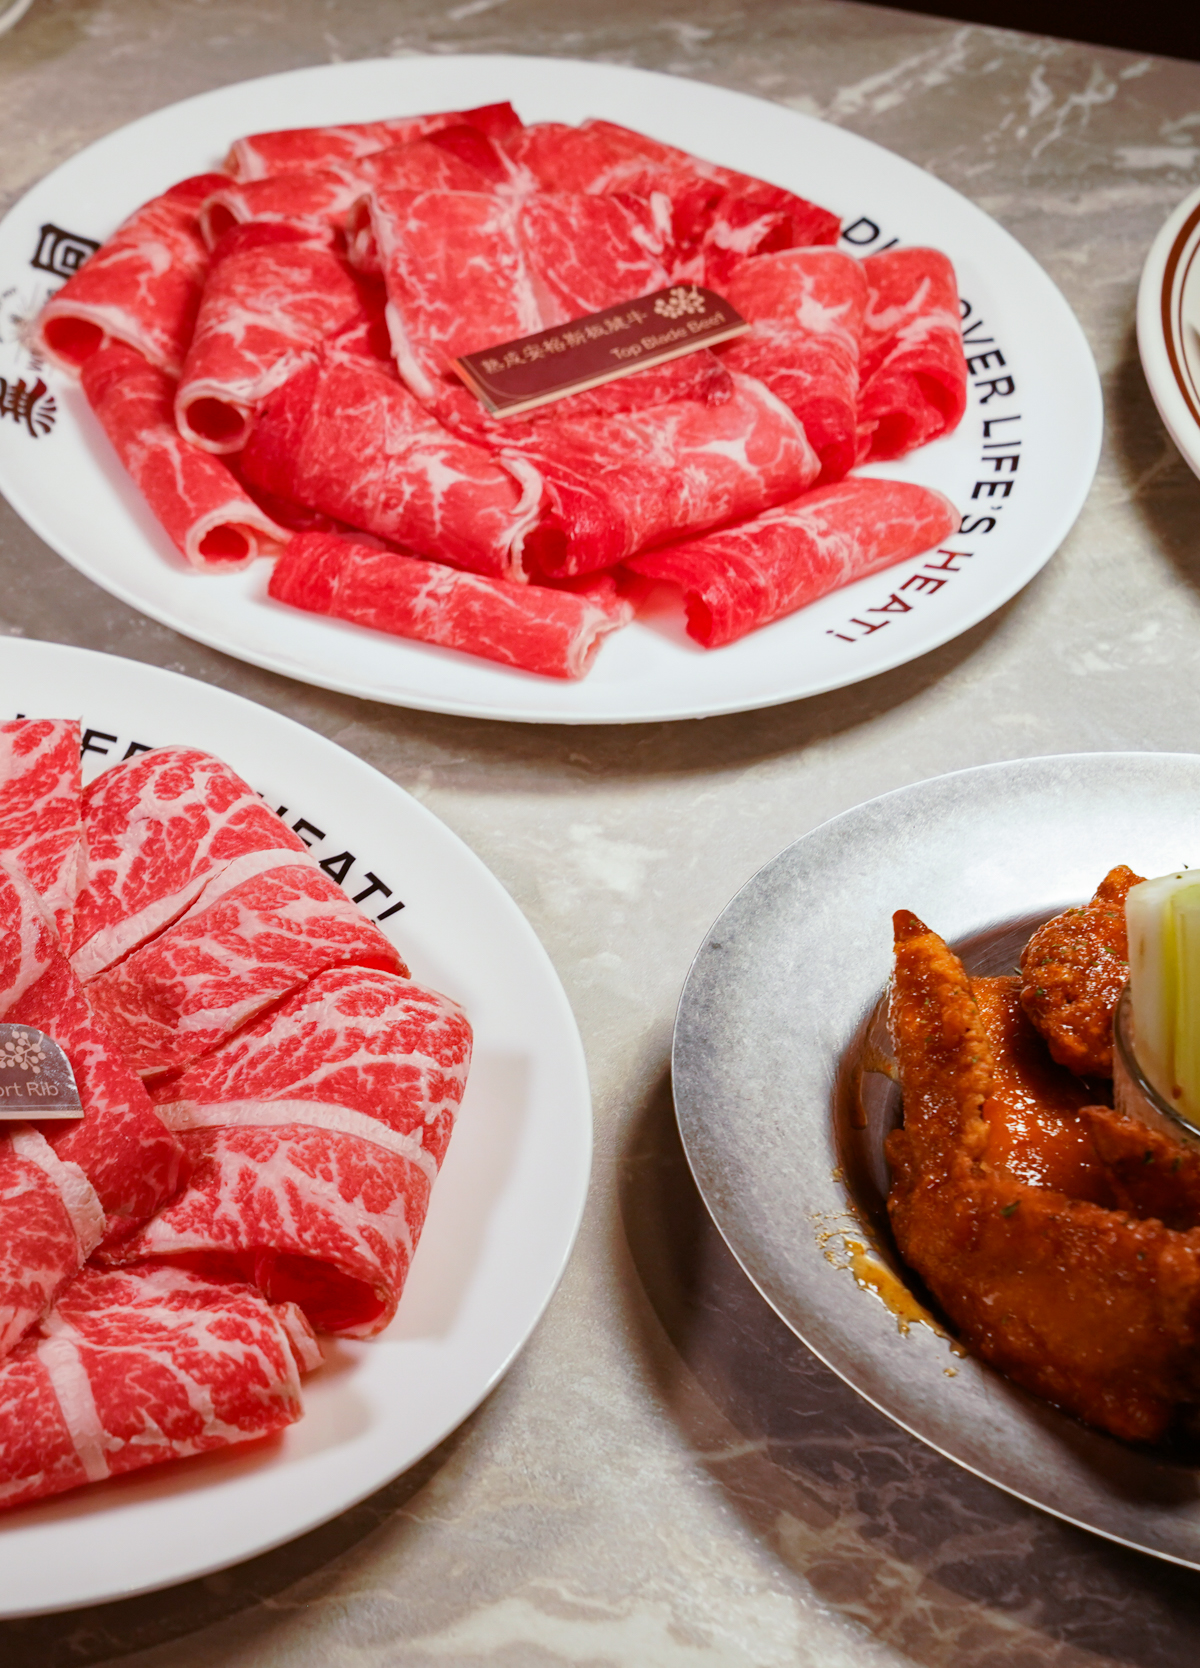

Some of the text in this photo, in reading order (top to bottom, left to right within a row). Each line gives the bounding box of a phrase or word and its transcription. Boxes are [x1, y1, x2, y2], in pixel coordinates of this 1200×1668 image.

[609, 310, 726, 359] Top Blade Beef
[958, 414, 1022, 534] LIFE'S
[826, 549, 975, 643] HEAT!
[257, 790, 406, 926] EAT!
[25, 1080, 60, 1097] Rib
